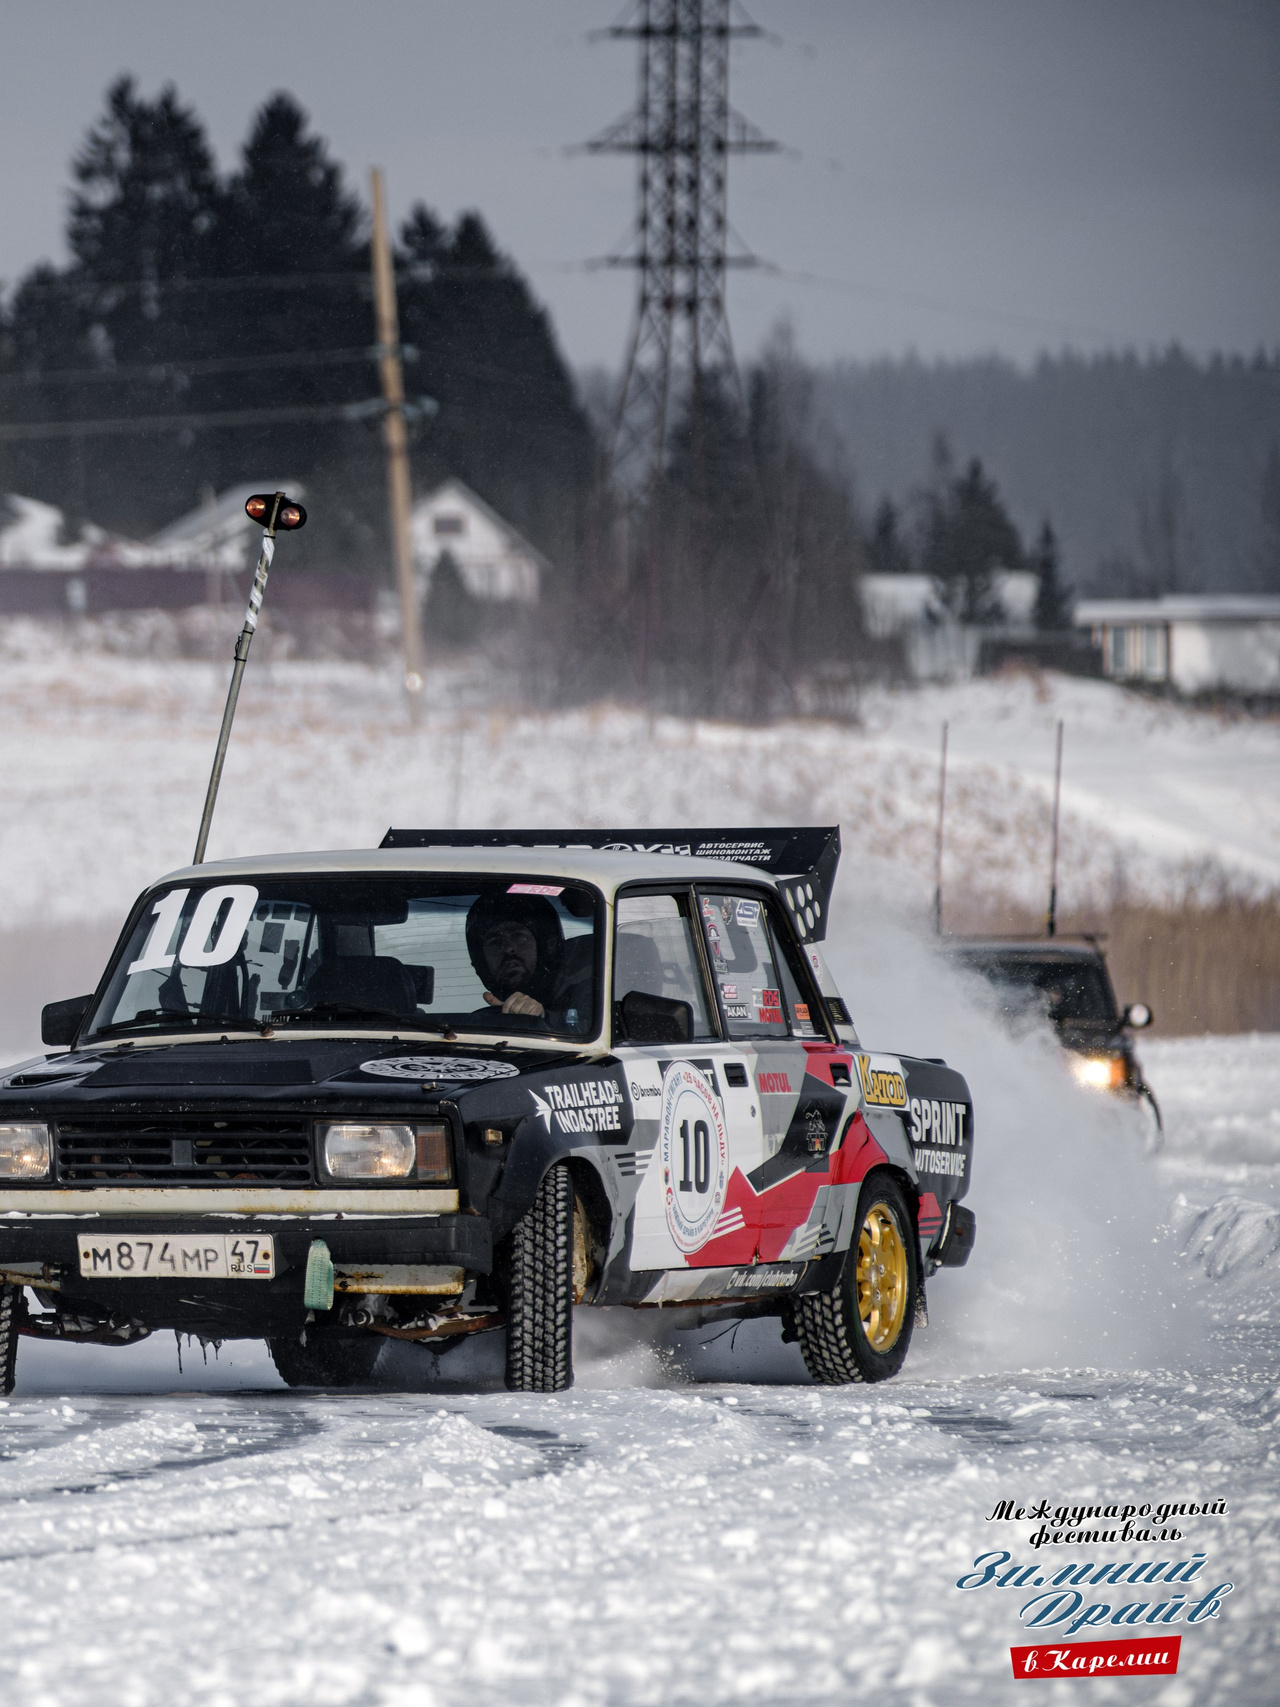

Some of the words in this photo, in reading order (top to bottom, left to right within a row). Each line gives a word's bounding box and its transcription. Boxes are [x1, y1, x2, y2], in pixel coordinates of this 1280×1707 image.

[127, 884, 259, 976] 10
[762, 990, 780, 1006] RDS
[758, 1008, 783, 1023] MOTUL
[639, 1084, 662, 1097] brembo
[758, 1073, 792, 1094] MOTUL
[554, 1105, 622, 1134] INDASTREE
[711, 1103, 720, 1121] НА
[911, 1098, 967, 1147] SPRINT
[680, 1119, 711, 1195] 10
[91, 1242, 219, 1273] М874МР
[231, 1240, 260, 1264] 47
[230, 1263, 254, 1274] RUS
